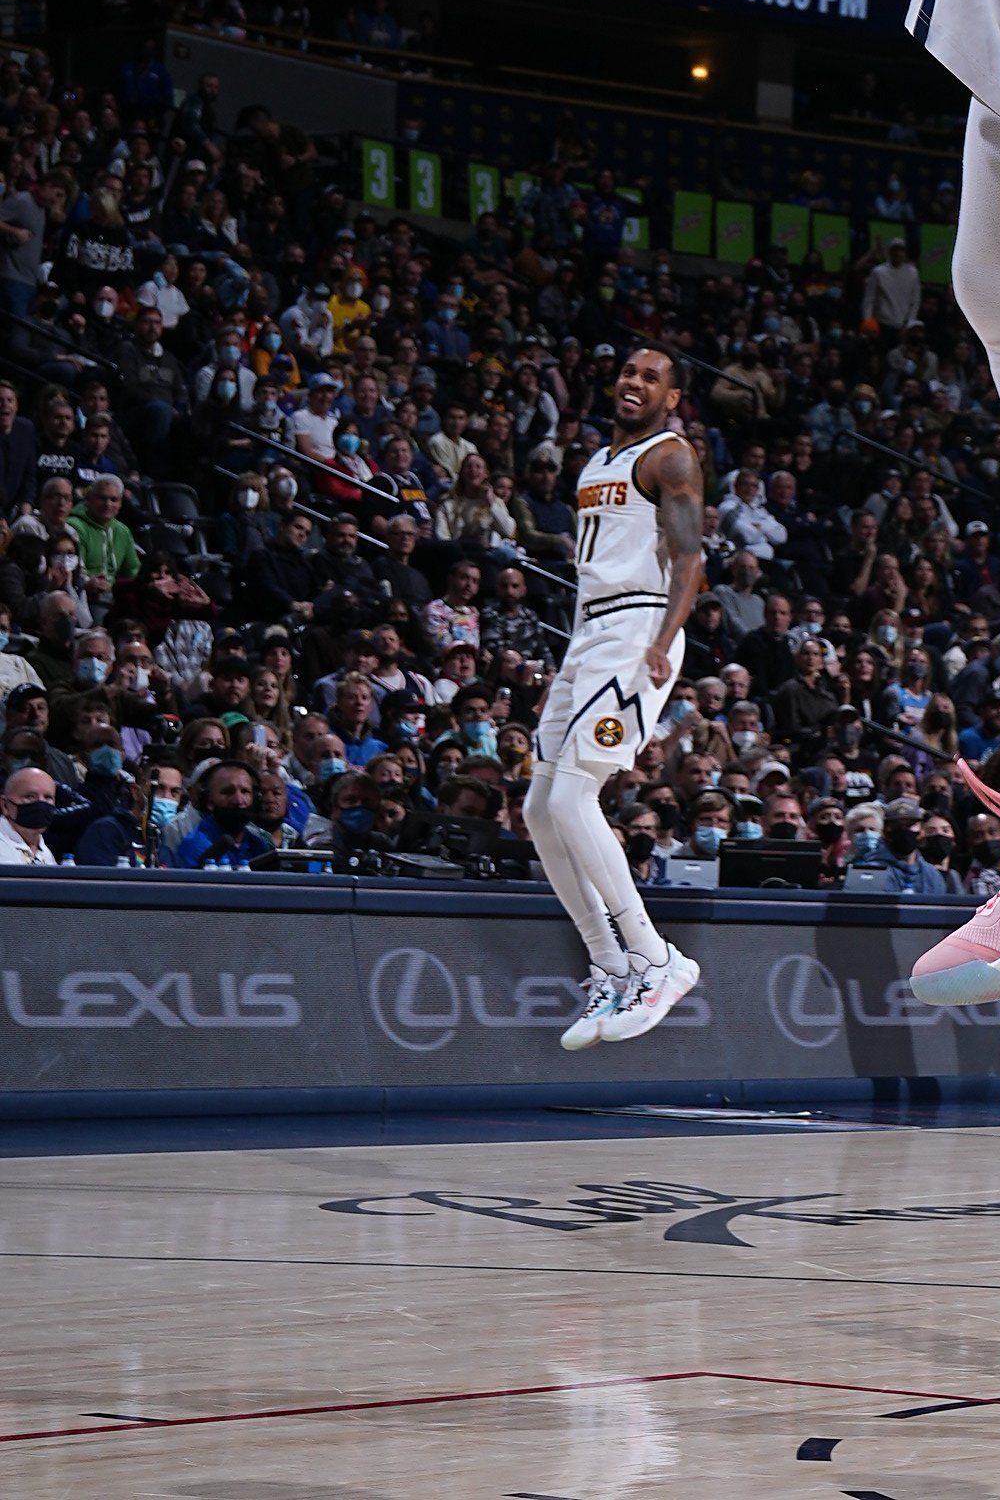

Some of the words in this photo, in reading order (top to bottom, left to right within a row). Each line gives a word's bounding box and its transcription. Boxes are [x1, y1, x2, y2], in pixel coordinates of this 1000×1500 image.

[370, 148, 390, 200] 3
[416, 158, 436, 210] 3
[578, 515, 600, 564] 11
[1, 969, 302, 1028] LEXUS
[468, 975, 711, 1027] LES
[319, 1180, 737, 1231] Ball
